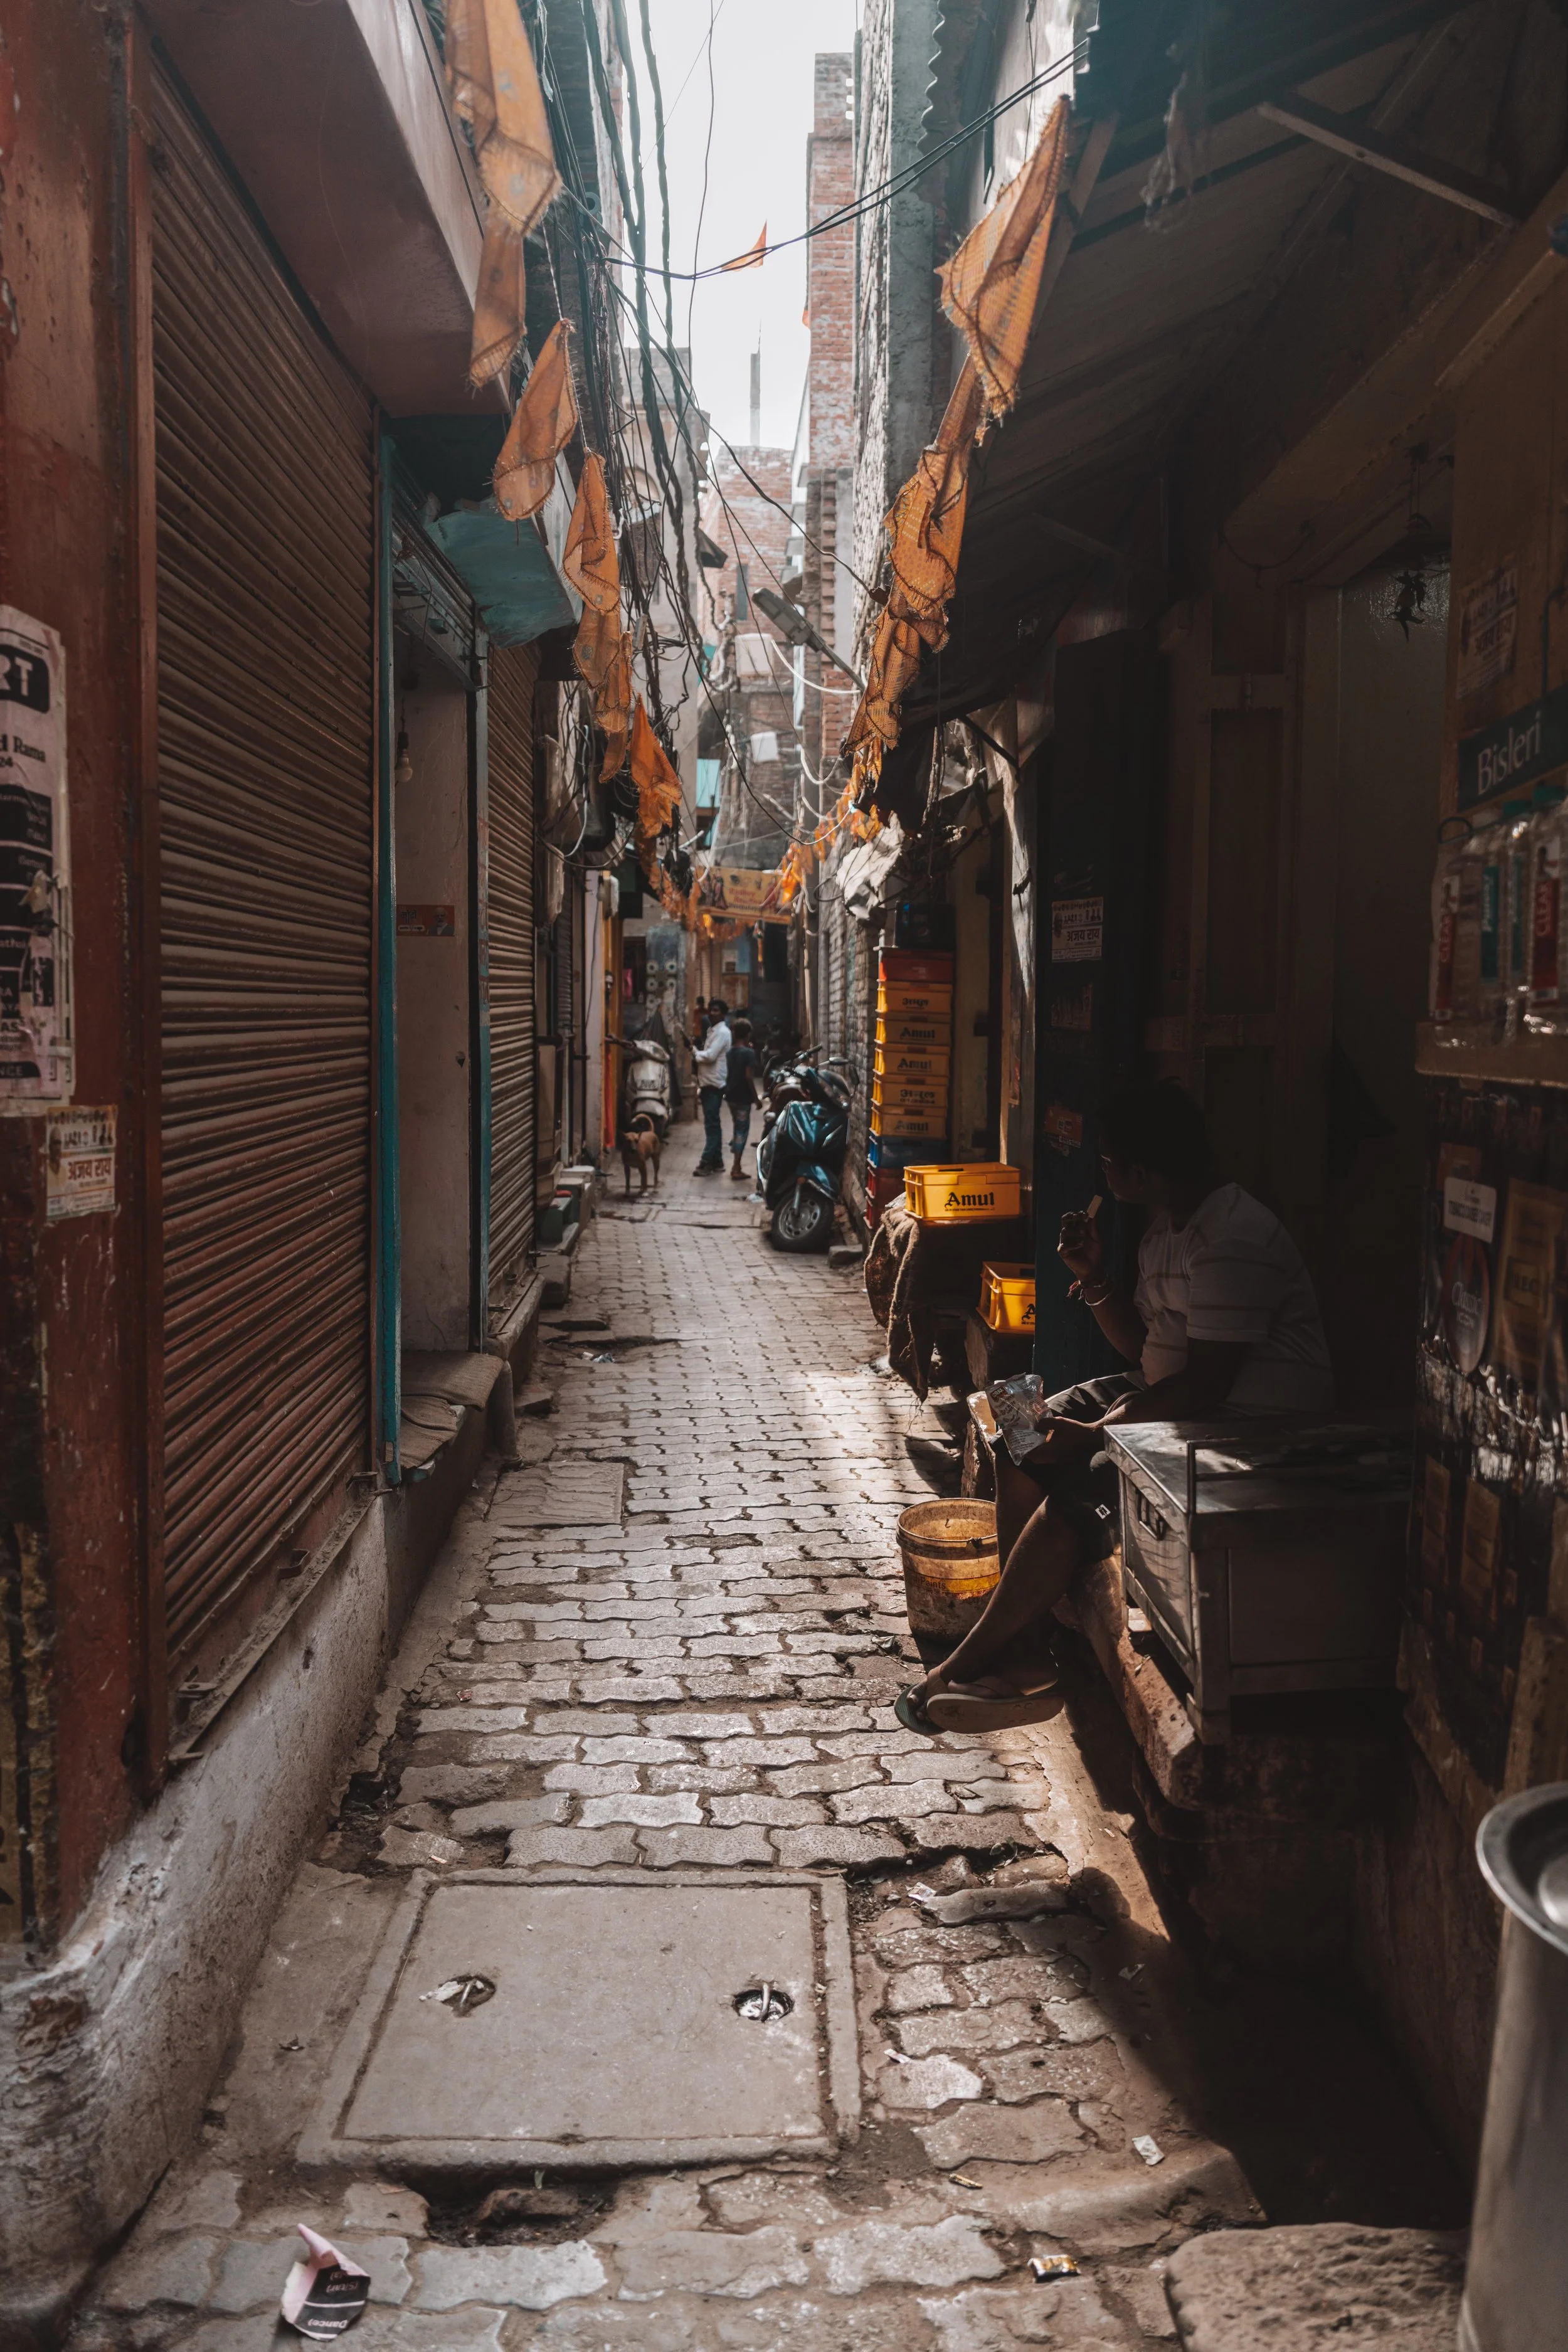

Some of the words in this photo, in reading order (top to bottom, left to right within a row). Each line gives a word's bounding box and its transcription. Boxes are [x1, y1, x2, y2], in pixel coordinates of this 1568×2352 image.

[13, 735, 46, 763] Rama
[1476, 709, 1543, 797] Bisleri
[1066, 929, 1086, 942] अजय
[1086, 928, 1101, 940] राय
[1439, 914, 1451, 964] CLEAR
[899, 1027, 936, 1039] Amul
[897, 1057, 932, 1071] Amul
[894, 1120, 929, 1132] Amul
[67, 1158, 92, 1180] अजय
[94, 1157, 112, 1178] राय
[944, 1192, 995, 1209] Amul
[920, 1577, 946, 1590] Paints
[307, 2318, 348, 2329] Dance)
